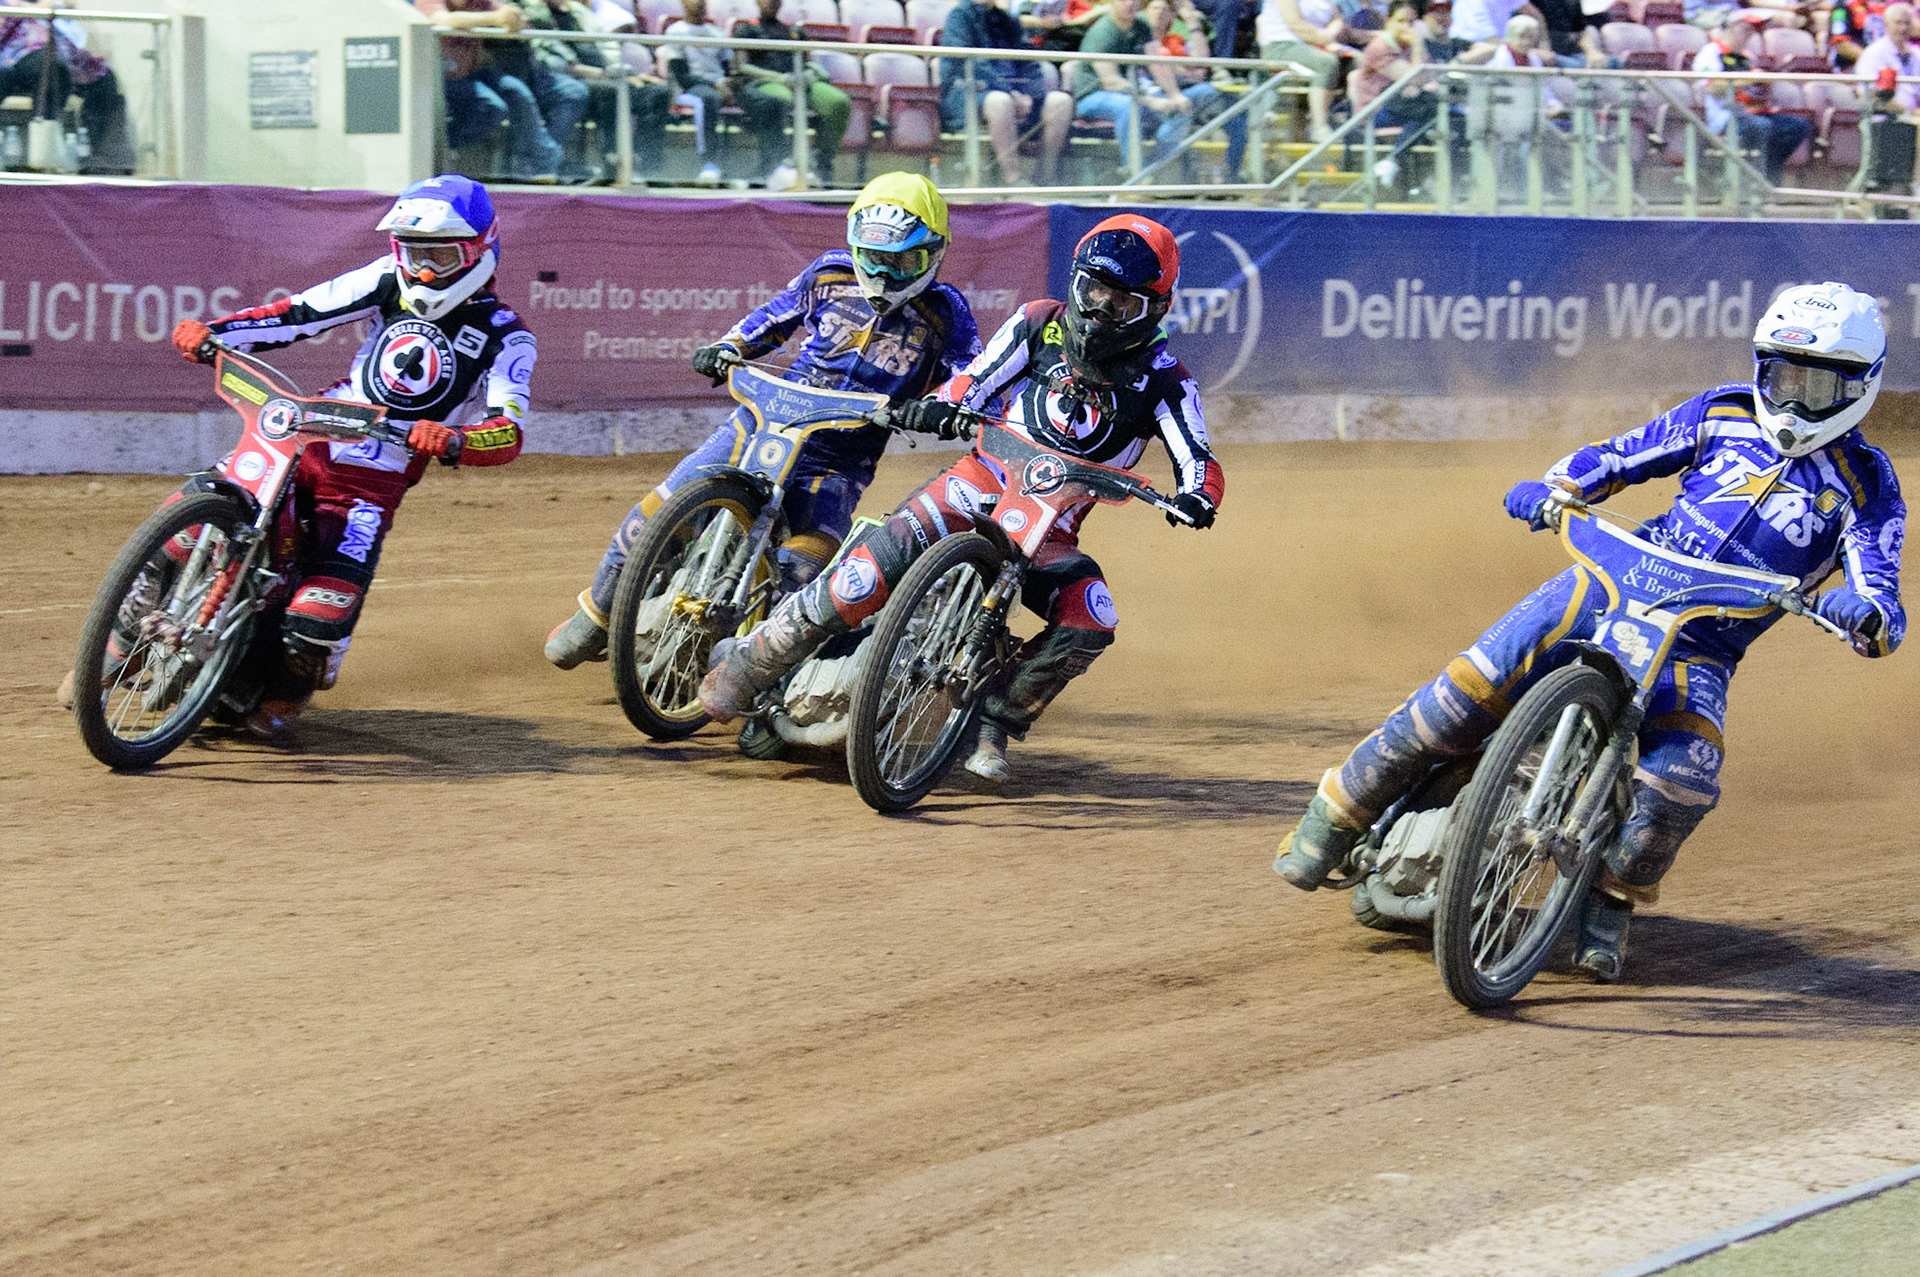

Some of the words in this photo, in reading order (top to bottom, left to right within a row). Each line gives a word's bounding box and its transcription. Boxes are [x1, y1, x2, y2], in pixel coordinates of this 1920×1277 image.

[529, 280, 603, 309] Proud
[607, 283, 636, 310] to
[639, 287, 742, 316] sponsor
[746, 281, 782, 309] th
[1321, 278, 1587, 357] Delivering
[1604, 280, 1754, 340] World
[765, 399, 780, 414] &
[1622, 567, 1645, 587] &
[1635, 555, 1694, 586] Minors
